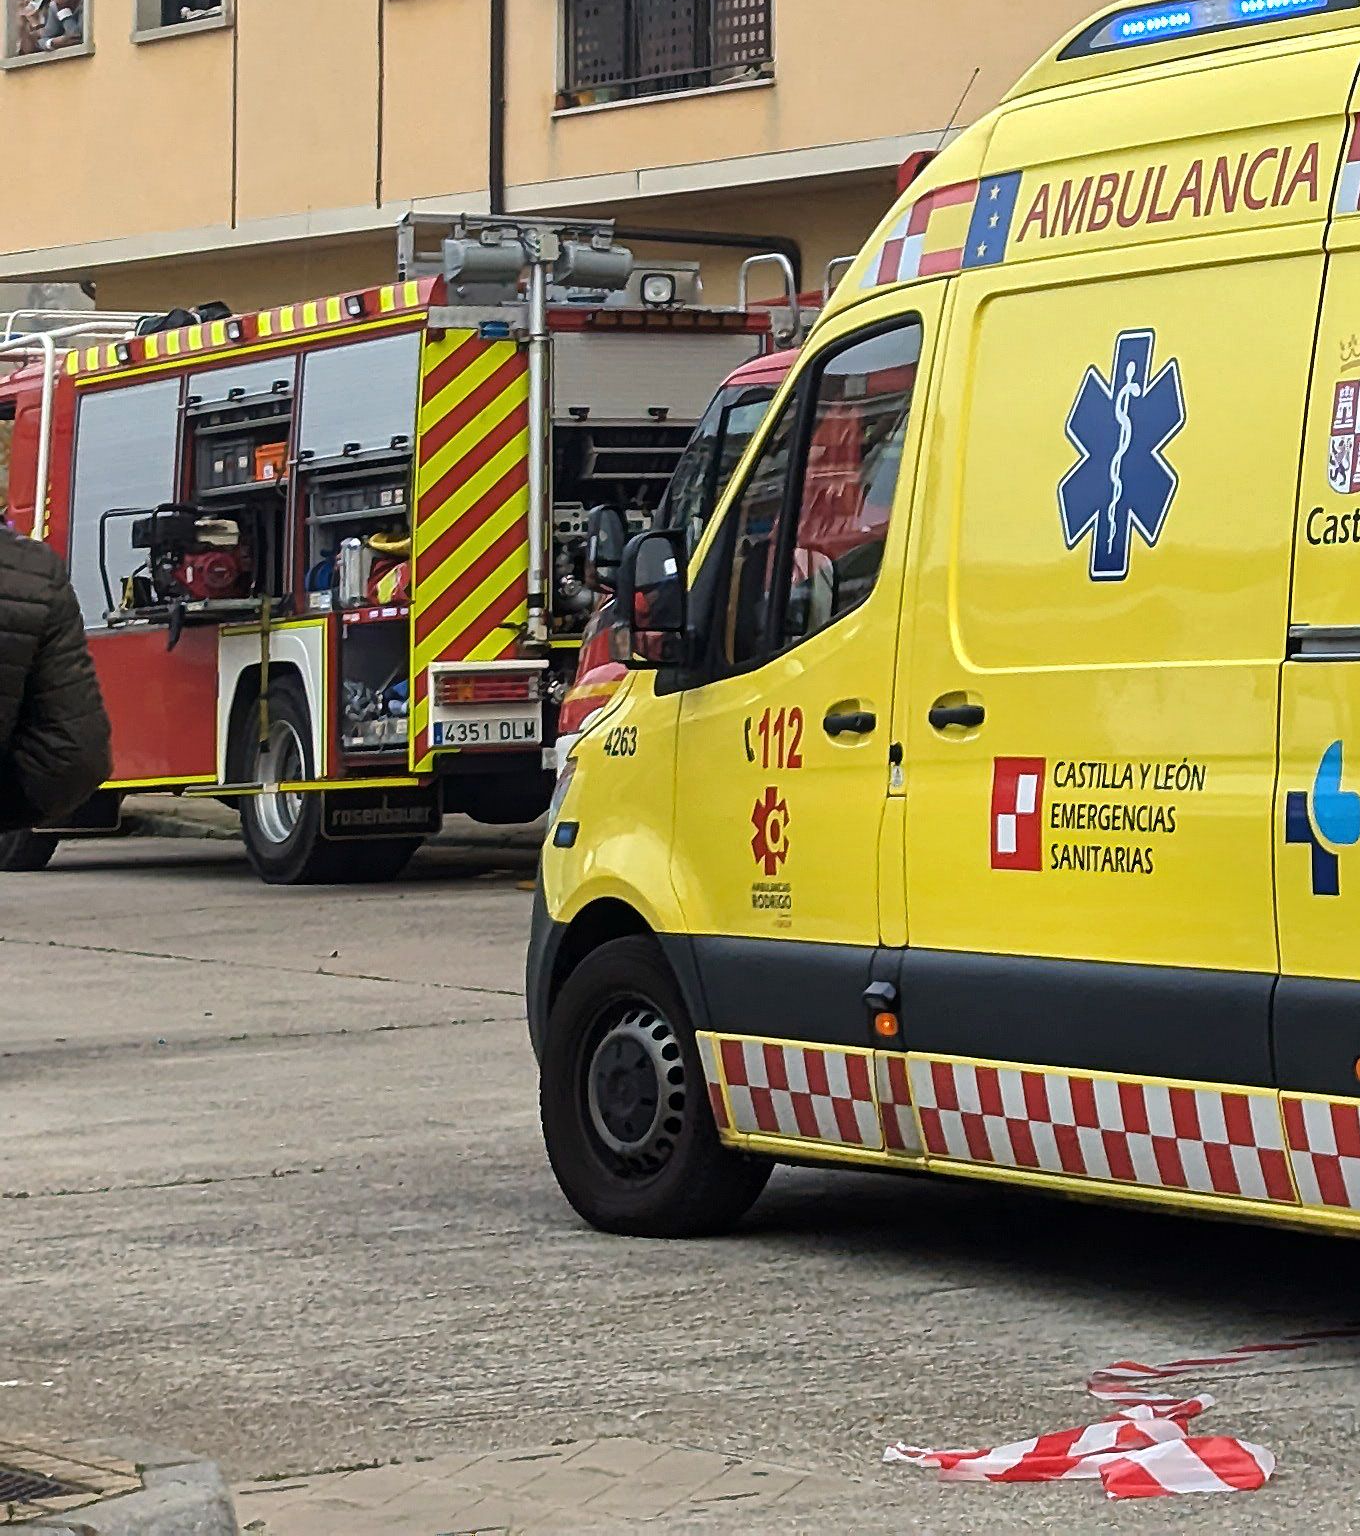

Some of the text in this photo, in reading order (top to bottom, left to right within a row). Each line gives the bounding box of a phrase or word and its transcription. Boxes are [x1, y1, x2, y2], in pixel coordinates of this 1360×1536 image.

[1015, 142, 1319, 242] AMBULANCIA
[444, 720, 535, 743] 4351 DLM
[604, 726, 638, 757] 4263
[758, 706, 803, 769] 112
[1053, 757, 1207, 791] CASTILLA Y LEÓN
[1051, 803, 1176, 833] EMERGENCIAS
[1051, 844, 1154, 874] SANITARIAS
[751, 894, 792, 909] RODRIGO
